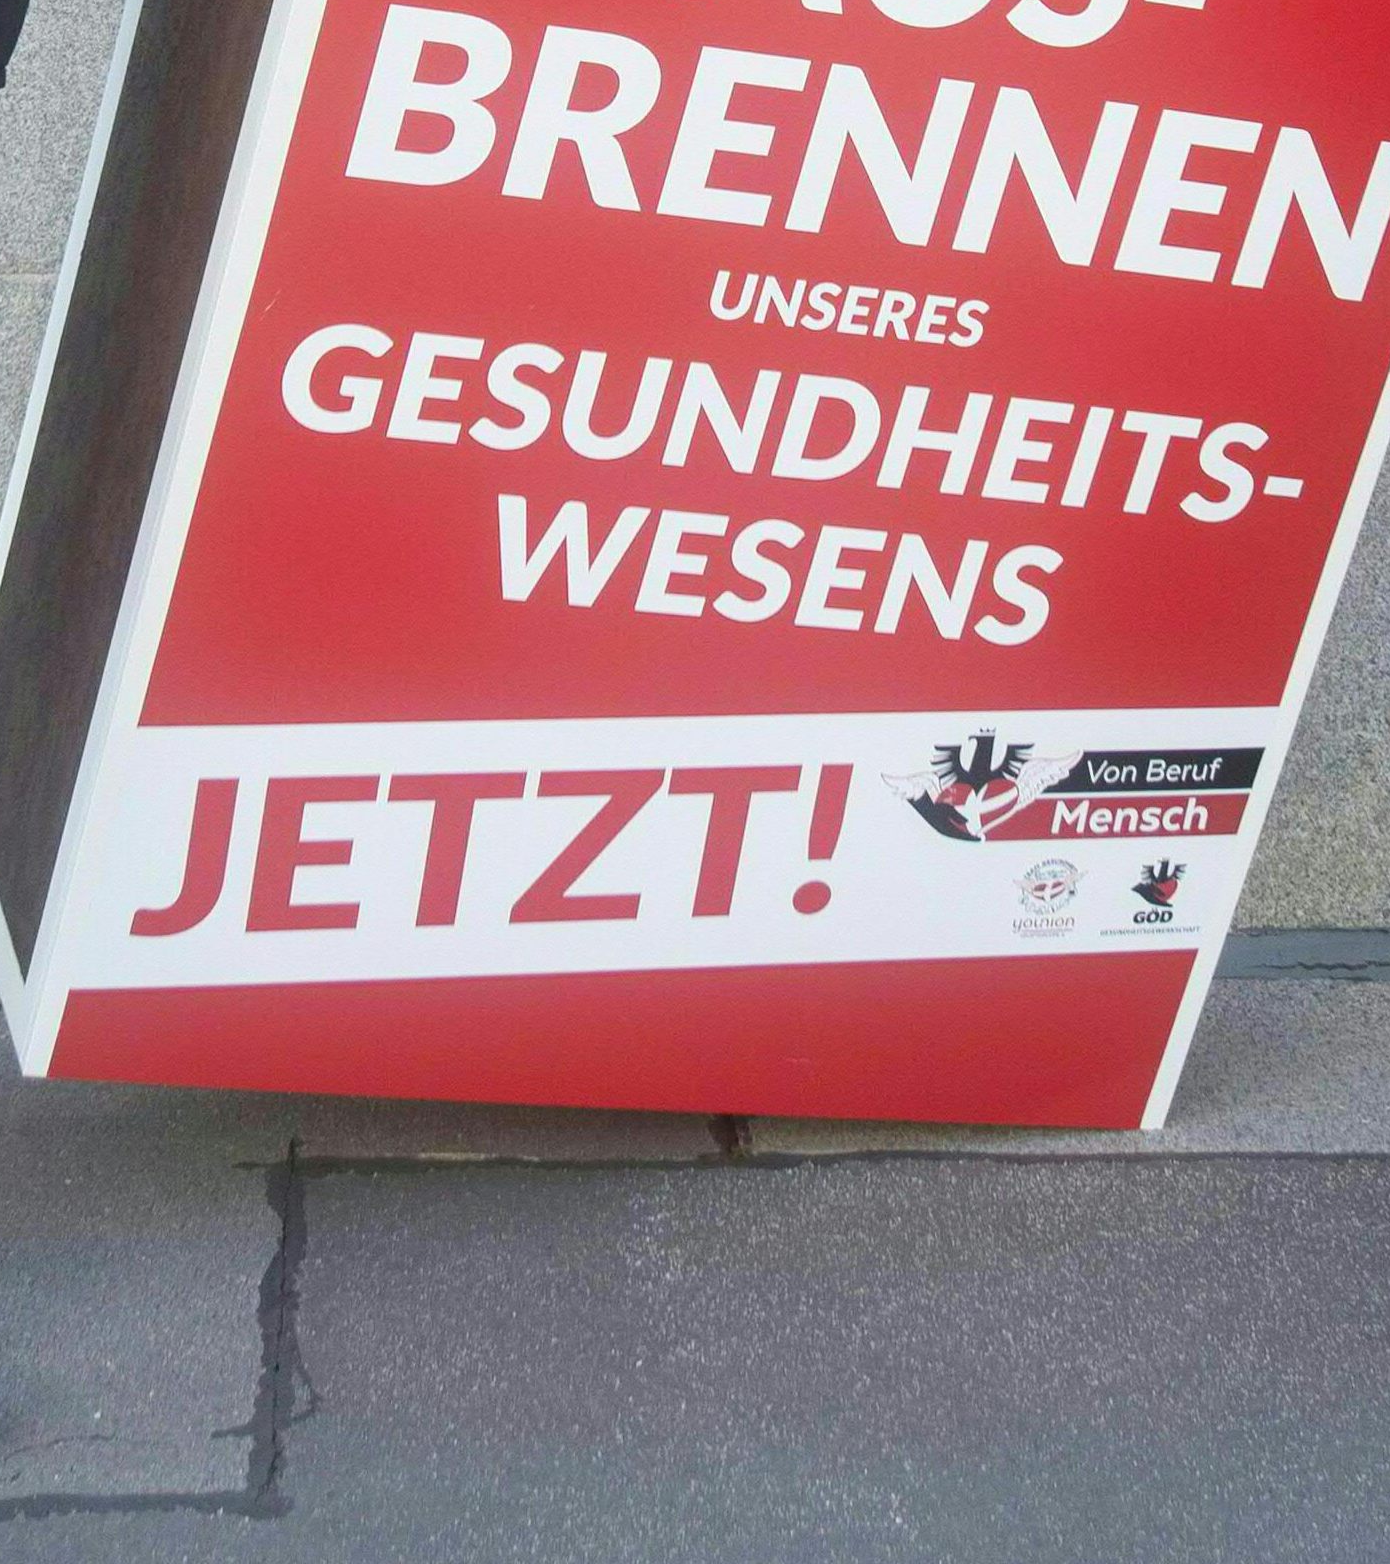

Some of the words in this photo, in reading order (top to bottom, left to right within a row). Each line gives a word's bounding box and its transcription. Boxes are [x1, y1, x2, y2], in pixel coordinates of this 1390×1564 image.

[708, 269, 990, 349] UNSERES
[280, 324, 1302, 524] GESUNDHEITS-
[497, 495, 1064, 647] WESENS
[1087, 759, 1138, 784] Von
[1146, 757, 1223, 782] Beruf
[130, 764, 849, 938] JETZT!
[1051, 797, 1209, 834] Mensch
[1133, 908, 1174, 924] GÖD
